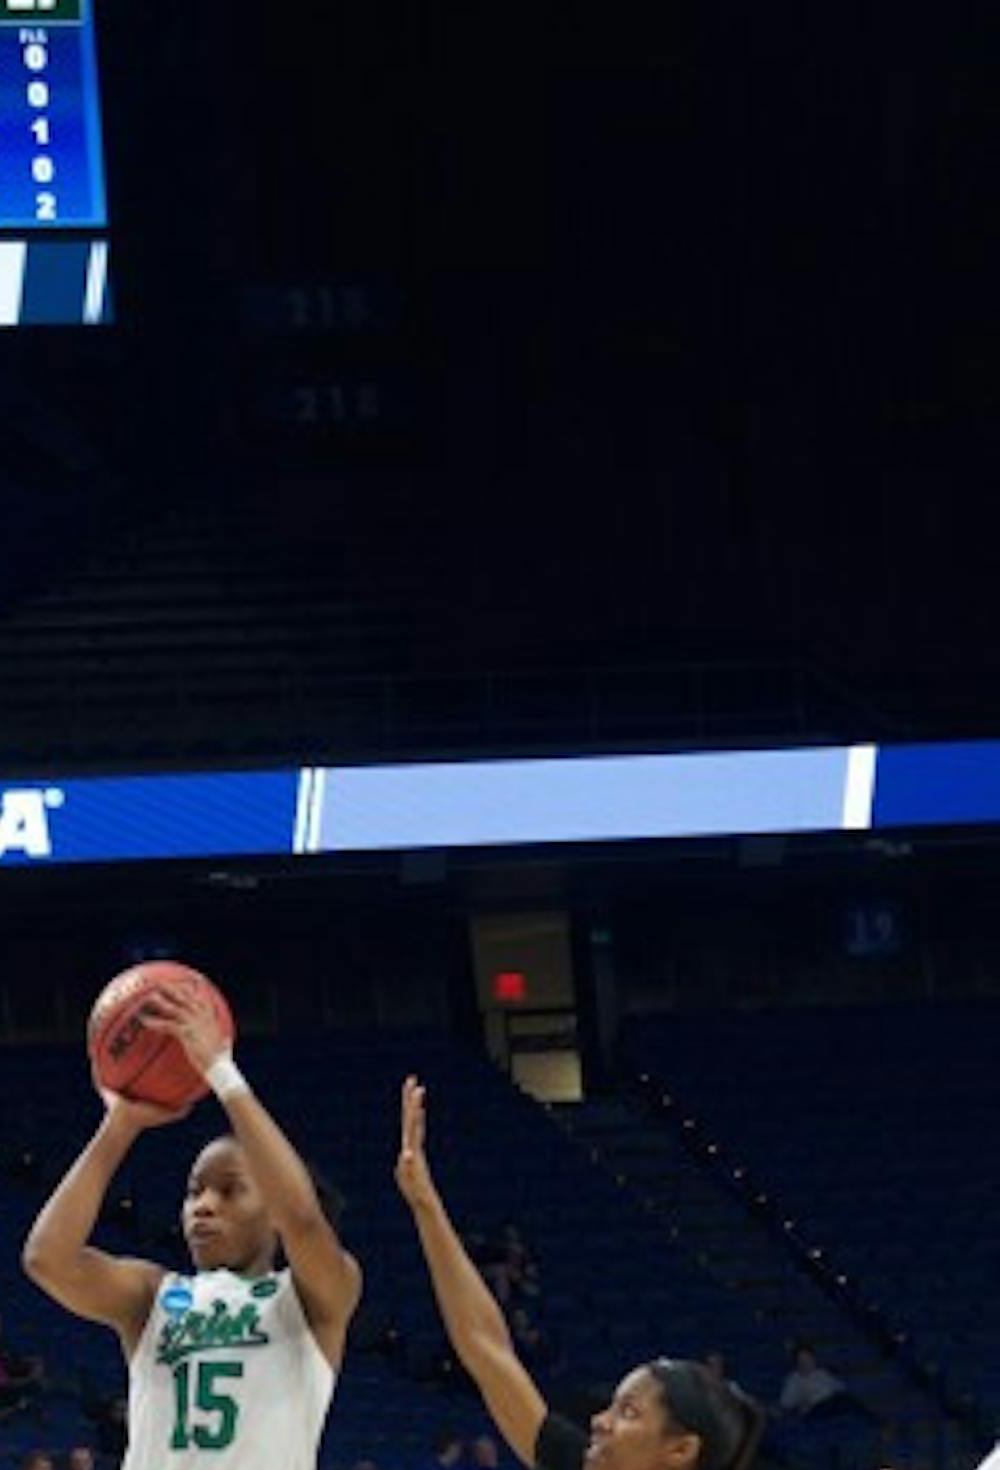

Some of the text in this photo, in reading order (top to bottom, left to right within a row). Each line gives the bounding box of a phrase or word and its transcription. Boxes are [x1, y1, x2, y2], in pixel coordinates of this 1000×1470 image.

[24, 44, 47, 71] 0
[28, 82, 48, 108] 0
[31, 118, 48, 145] 1
[32, 156, 53, 183] 0
[36, 193, 56, 221] 2
[170, 1361, 244, 1449] 15
